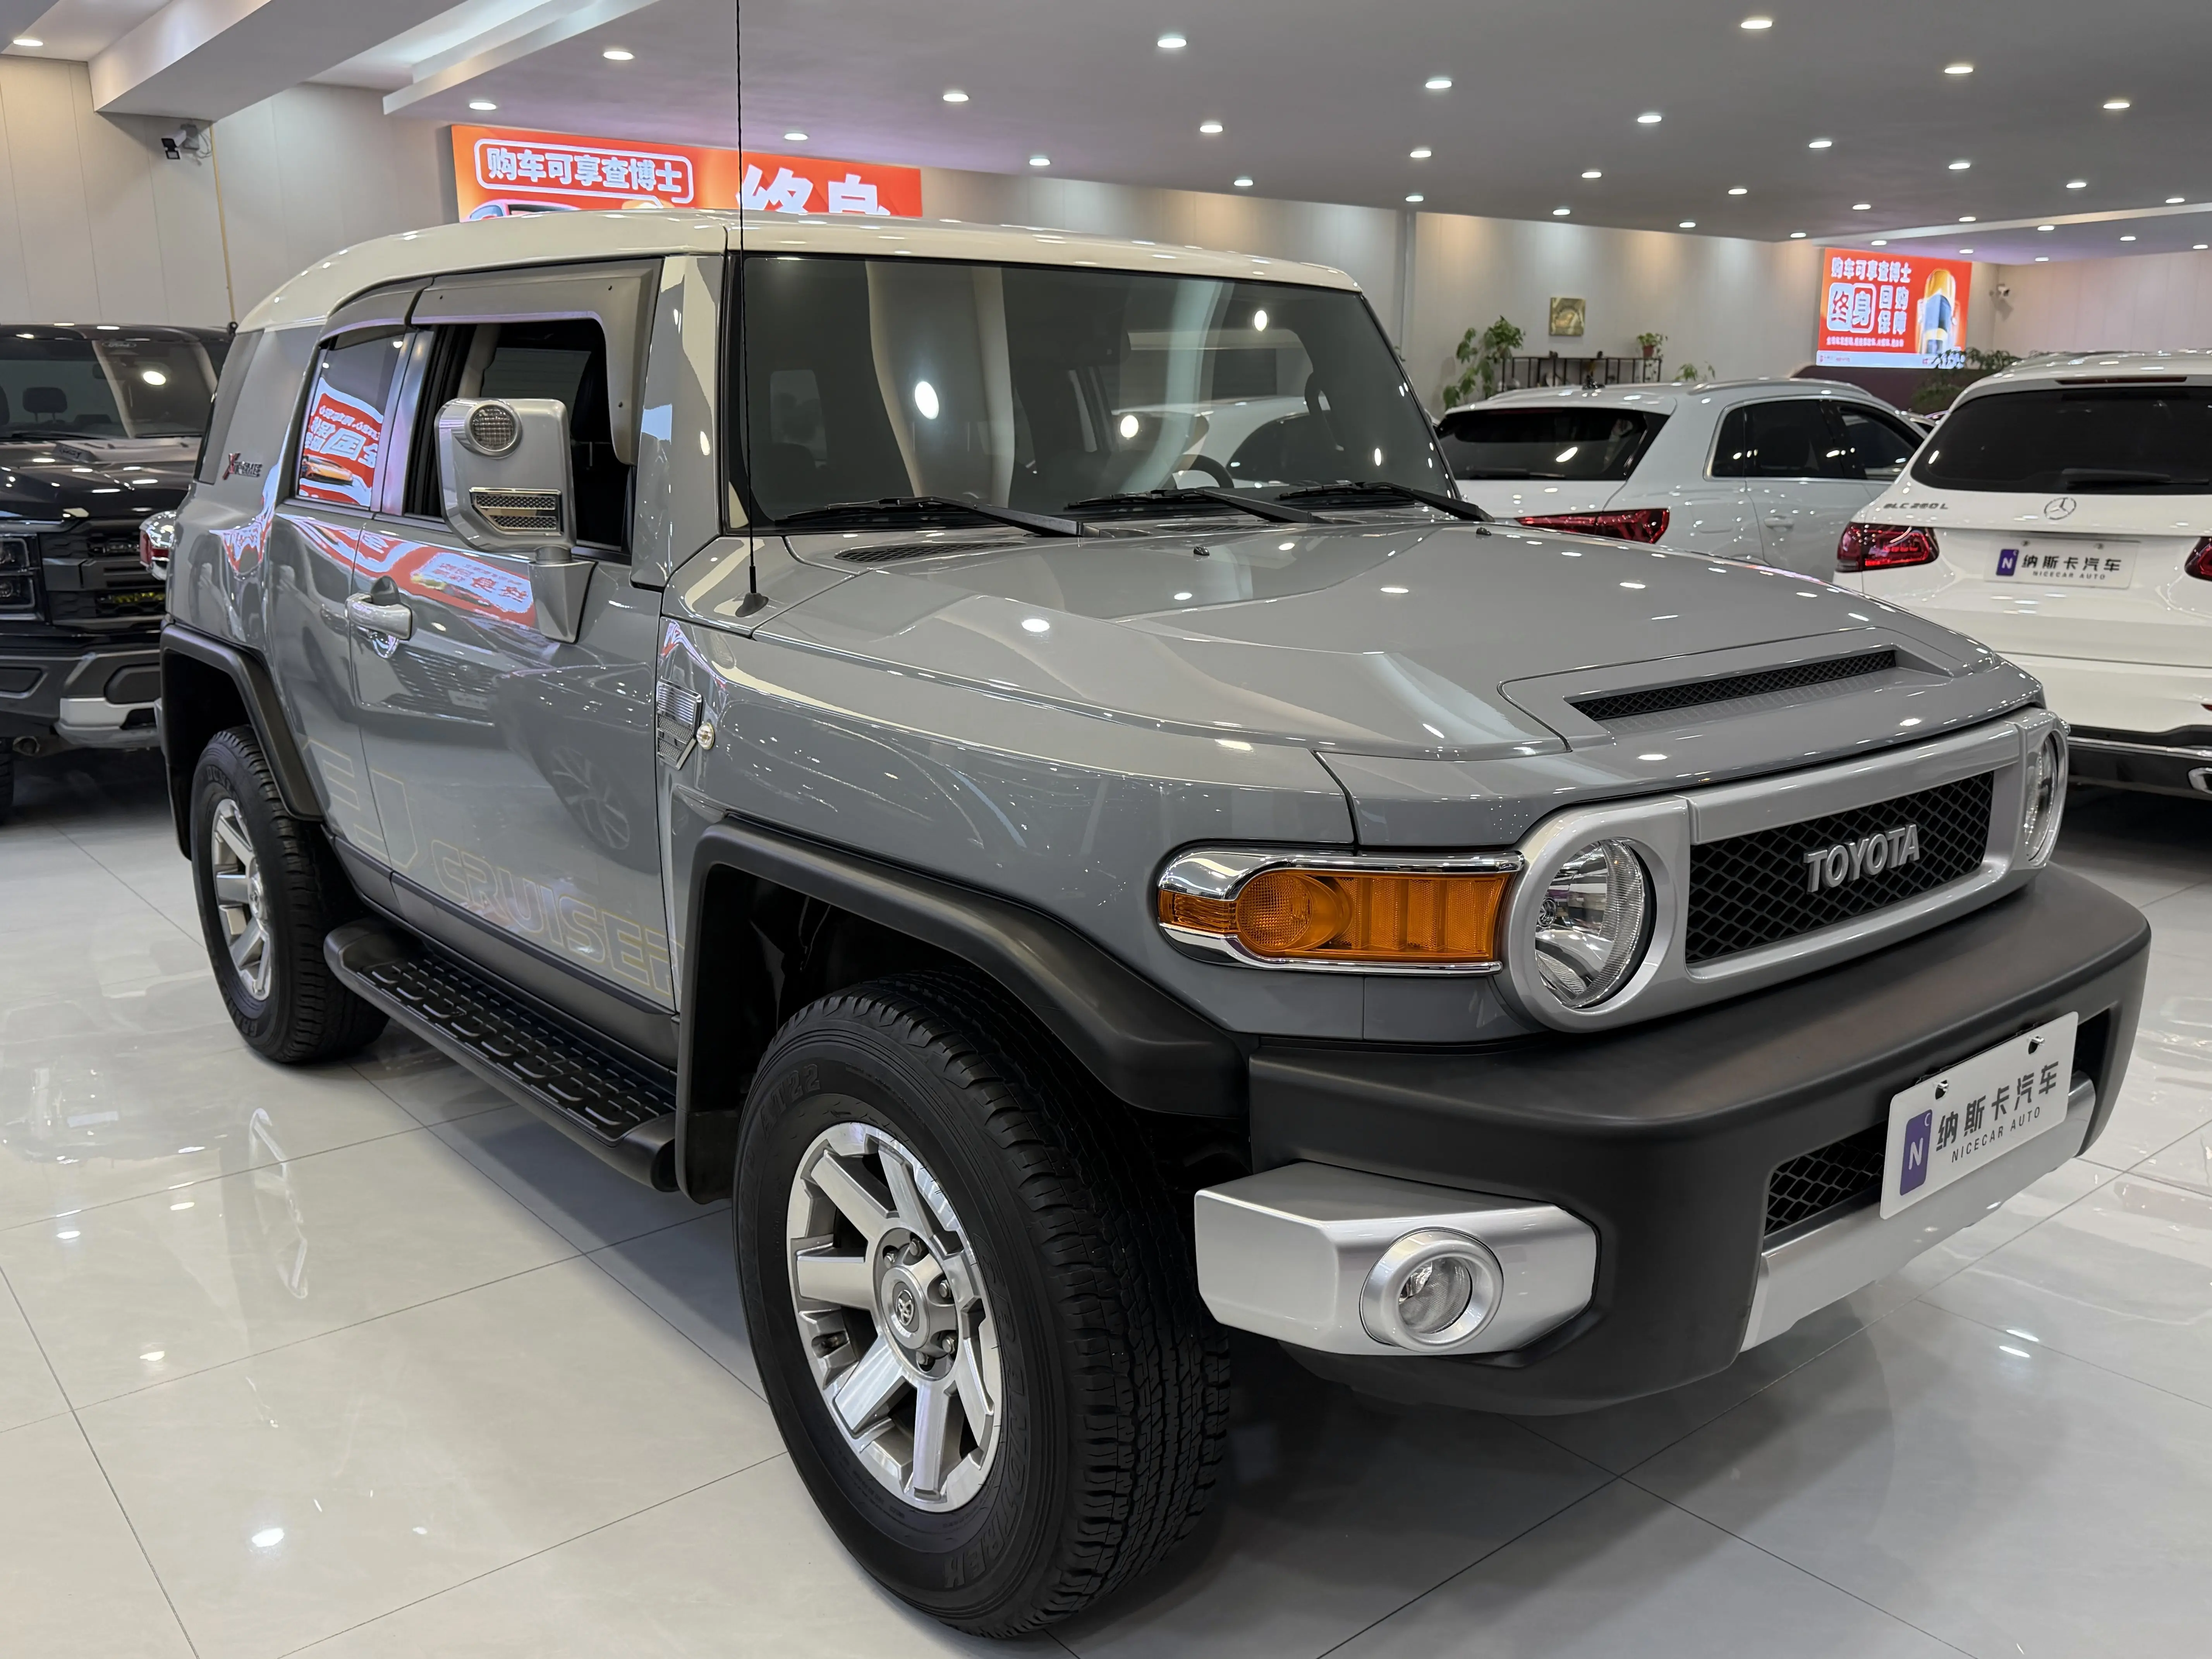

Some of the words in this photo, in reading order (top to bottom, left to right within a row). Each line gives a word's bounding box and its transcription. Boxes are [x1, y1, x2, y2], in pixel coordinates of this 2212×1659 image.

[486, 147, 683, 193] 购车可享查博士
[1831, 290, 1871, 326] 终身
[2001, 557, 2013, 569] N
[2021, 554, 2122, 572] 纳斯卡汽车
[1803, 823, 1920, 894] TOYOTA
[761, 1063, 821, 1137] AT22
[1936, 1061, 2059, 1152] 纳斯卡汽车
[1908, 1137, 1923, 1170] N
[1951, 1127, 2004, 1163] NICECAR
[2010, 1106, 2040, 1133] AUTO
